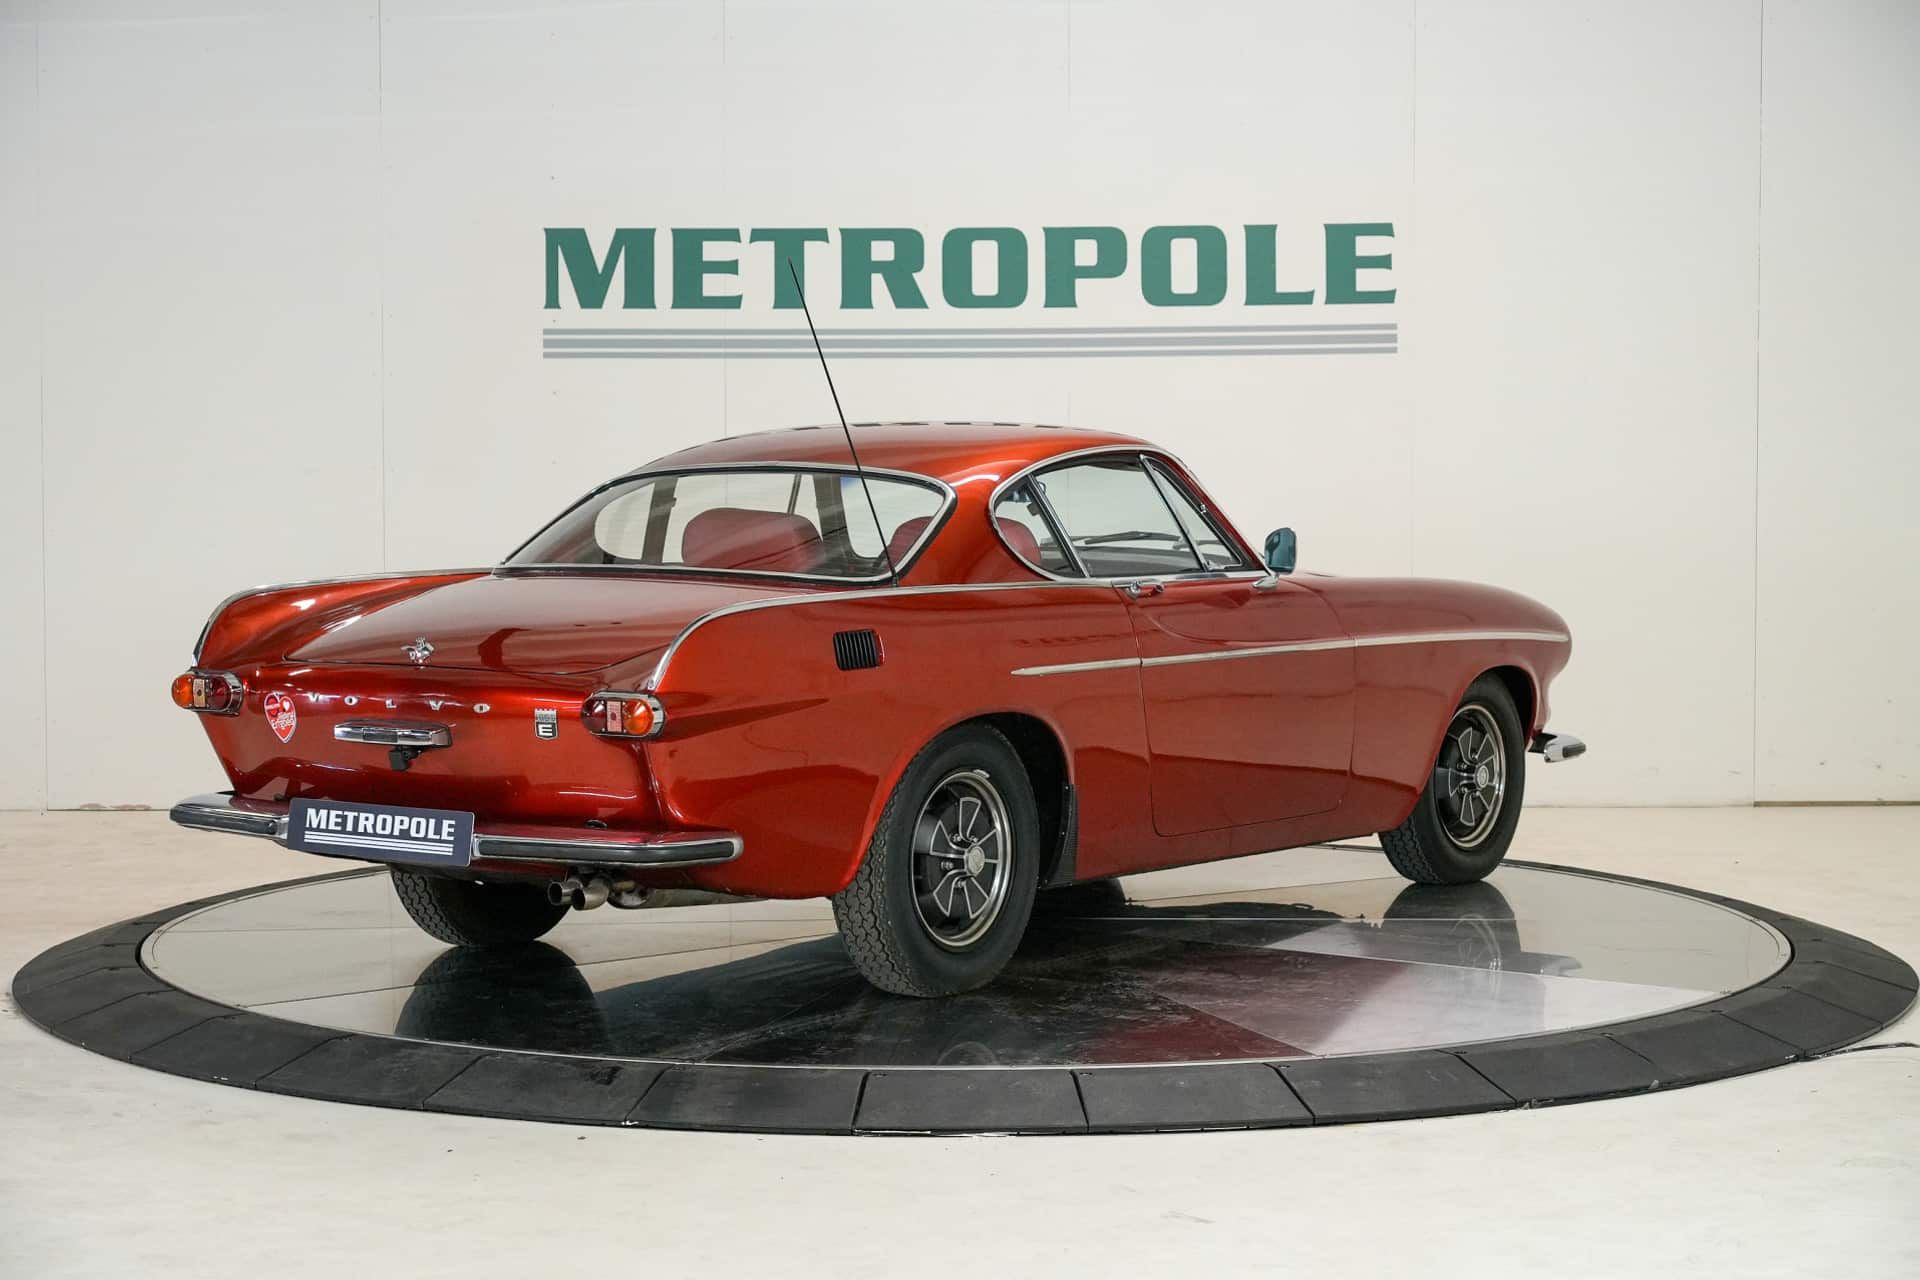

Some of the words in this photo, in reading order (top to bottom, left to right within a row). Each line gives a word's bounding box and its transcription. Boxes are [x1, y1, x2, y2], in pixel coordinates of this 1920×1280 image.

[543, 222, 1396, 310] METROPOLE
[307, 692, 491, 714] VOLVO
[538, 723, 553, 737] E
[305, 807, 456, 841] METROPOLE
